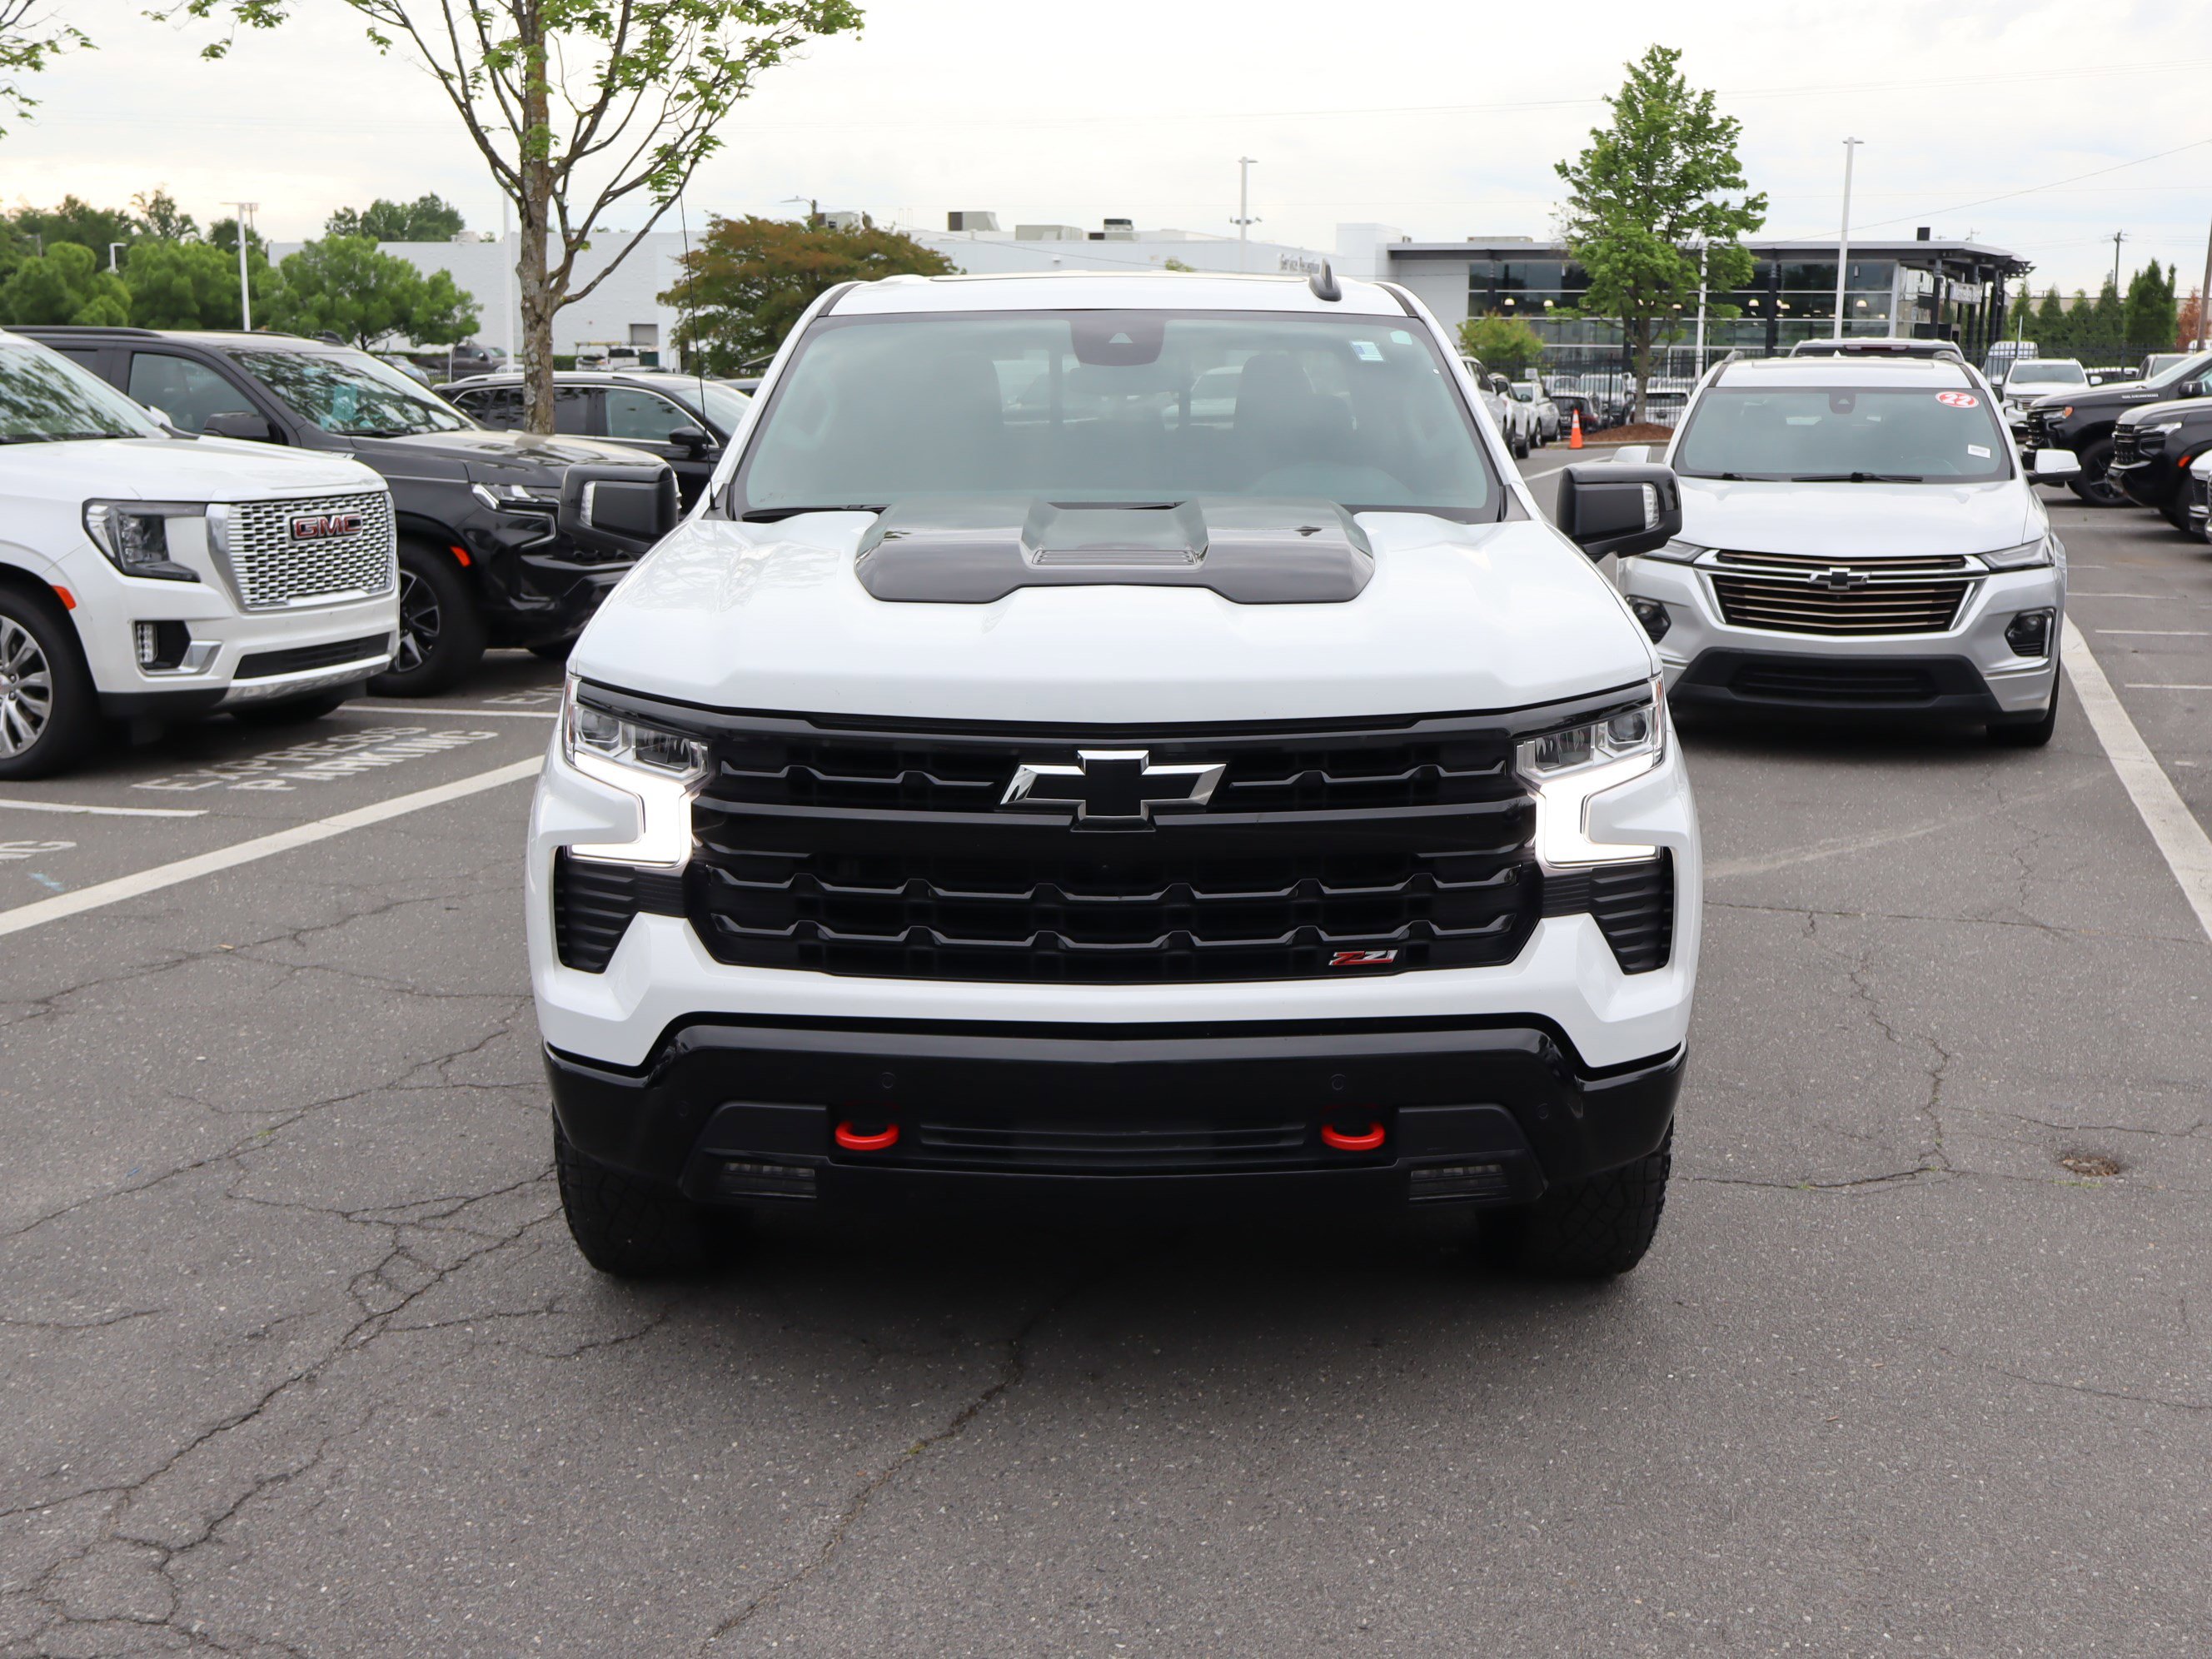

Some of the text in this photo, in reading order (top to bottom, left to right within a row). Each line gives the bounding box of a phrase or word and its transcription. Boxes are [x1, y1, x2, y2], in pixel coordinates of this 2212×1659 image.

[1940, 393, 1975, 406] 22
[292, 514, 363, 538] GMC
[131, 727, 426, 791] EXPRESS
[227, 730, 499, 791] PARKING
